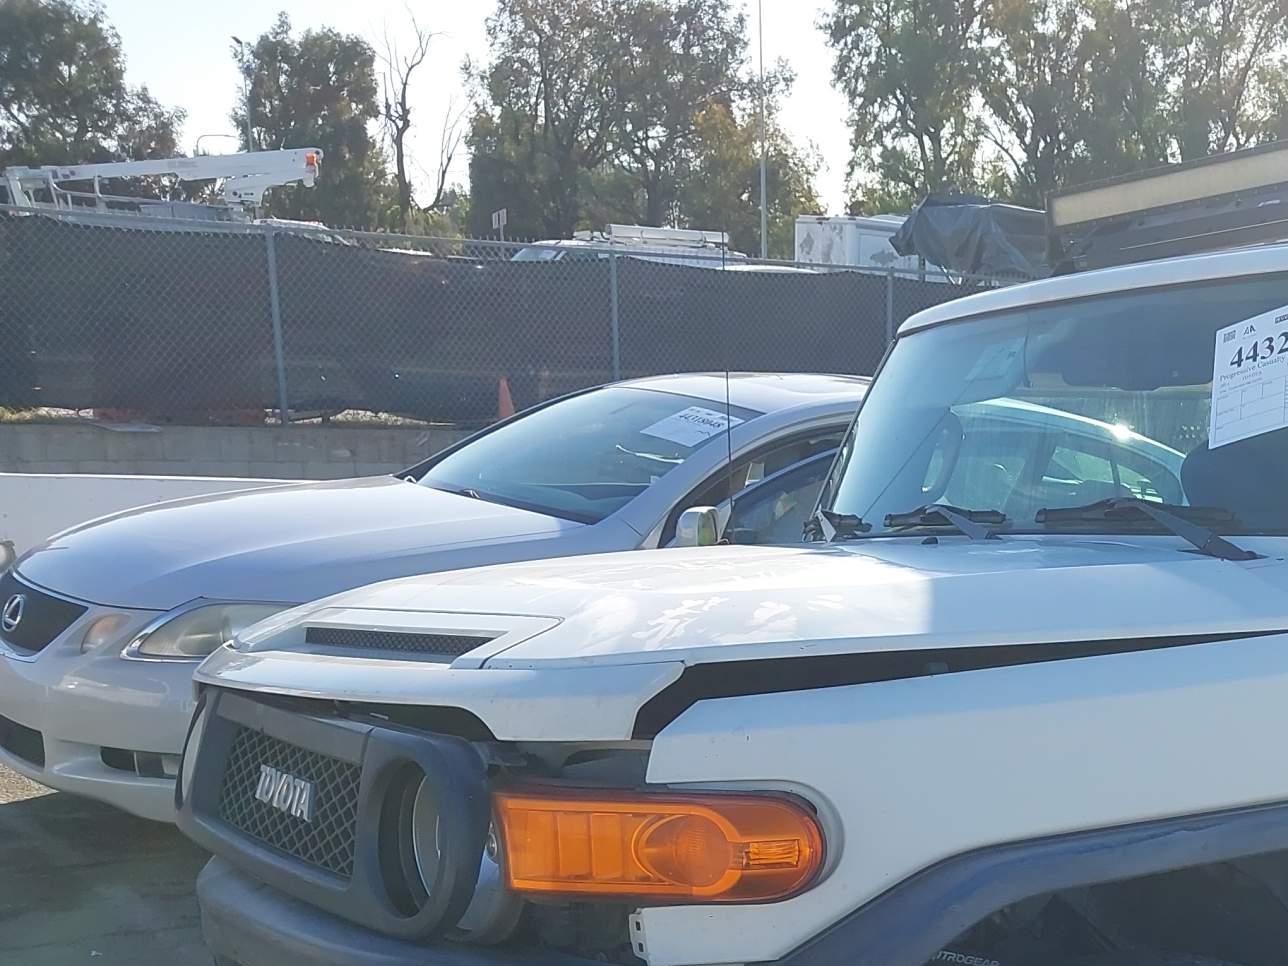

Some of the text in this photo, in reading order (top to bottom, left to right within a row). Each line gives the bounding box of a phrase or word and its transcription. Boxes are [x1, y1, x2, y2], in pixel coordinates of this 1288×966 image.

[1219, 365, 1256, 382] Progressive
[1257, 354, 1285, 369] Casualty
[255, 764, 313, 823] TOYOTA
